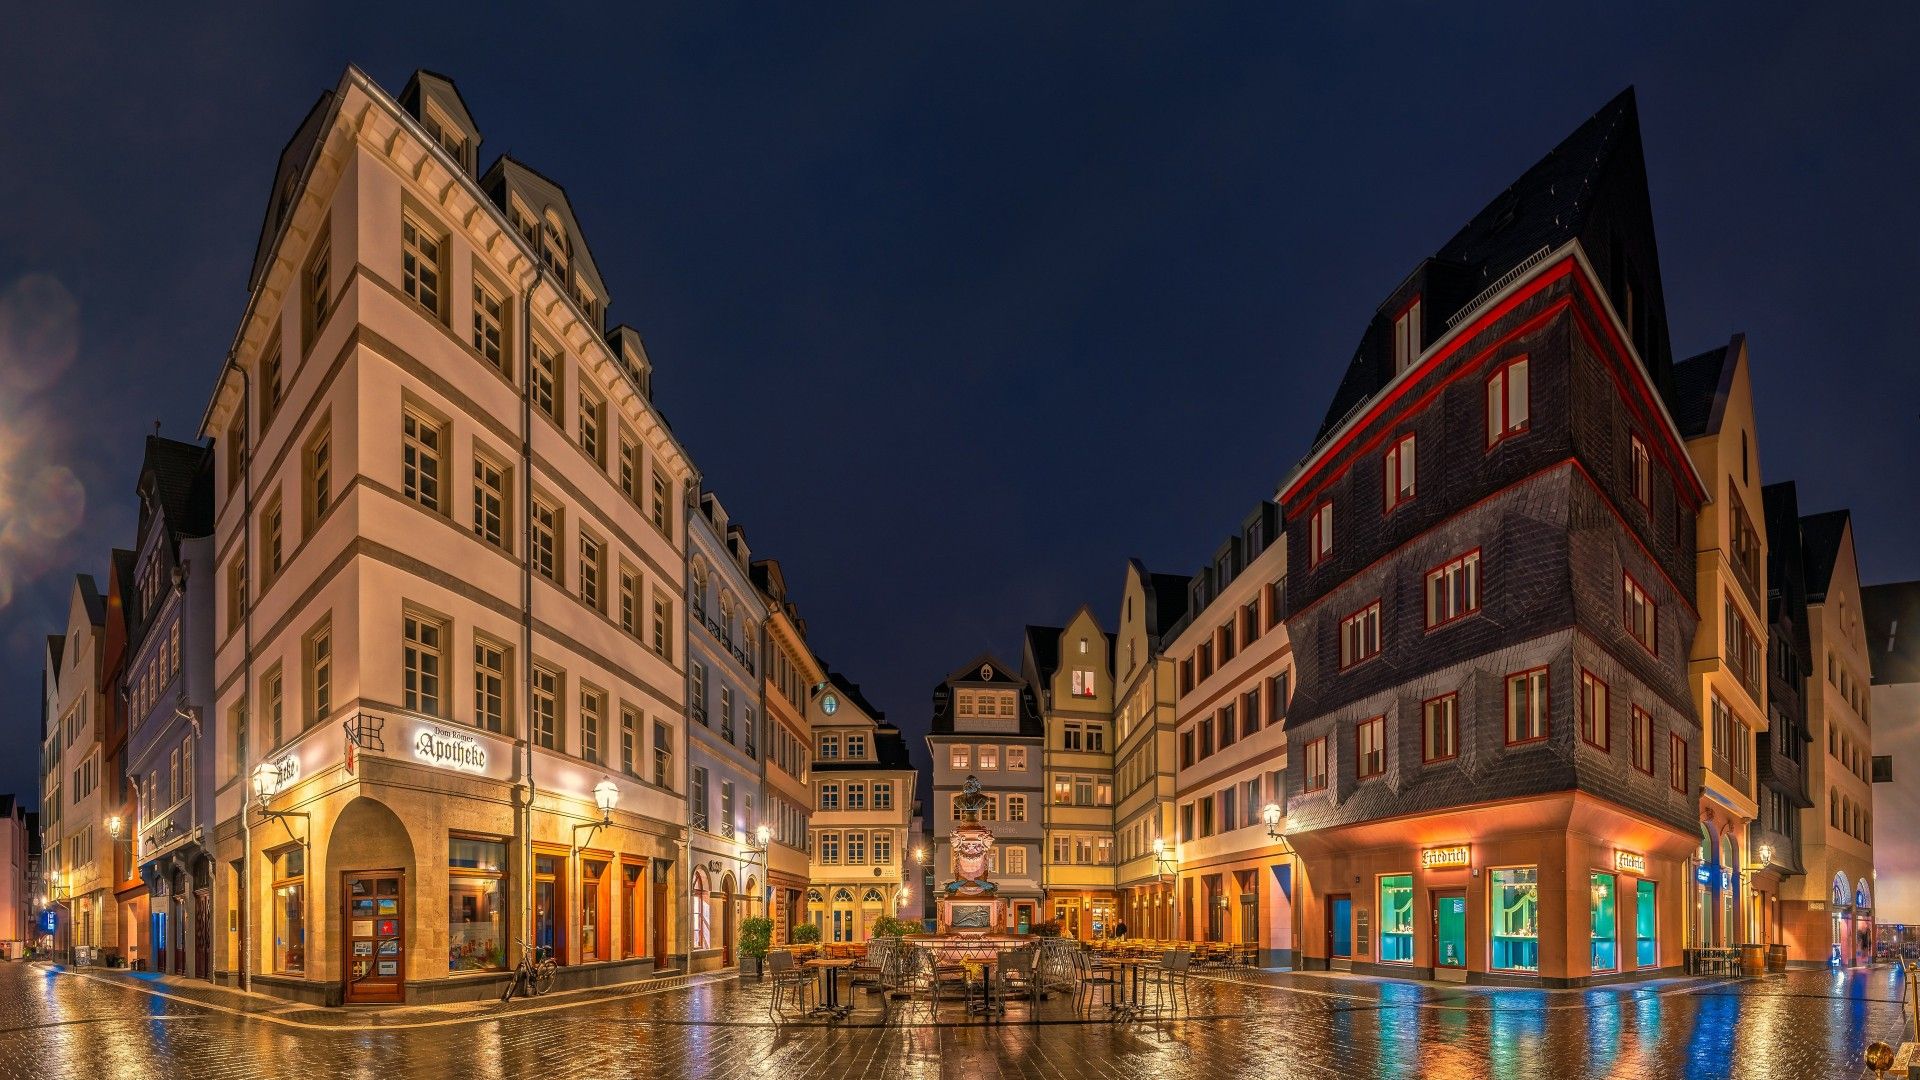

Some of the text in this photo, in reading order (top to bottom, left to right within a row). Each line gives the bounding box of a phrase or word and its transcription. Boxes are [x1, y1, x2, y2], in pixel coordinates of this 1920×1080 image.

[435, 727, 473, 743] Dom Römer
[420, 733, 485, 768] Apotheke
[1422, 848, 1466, 864] Friedrich
